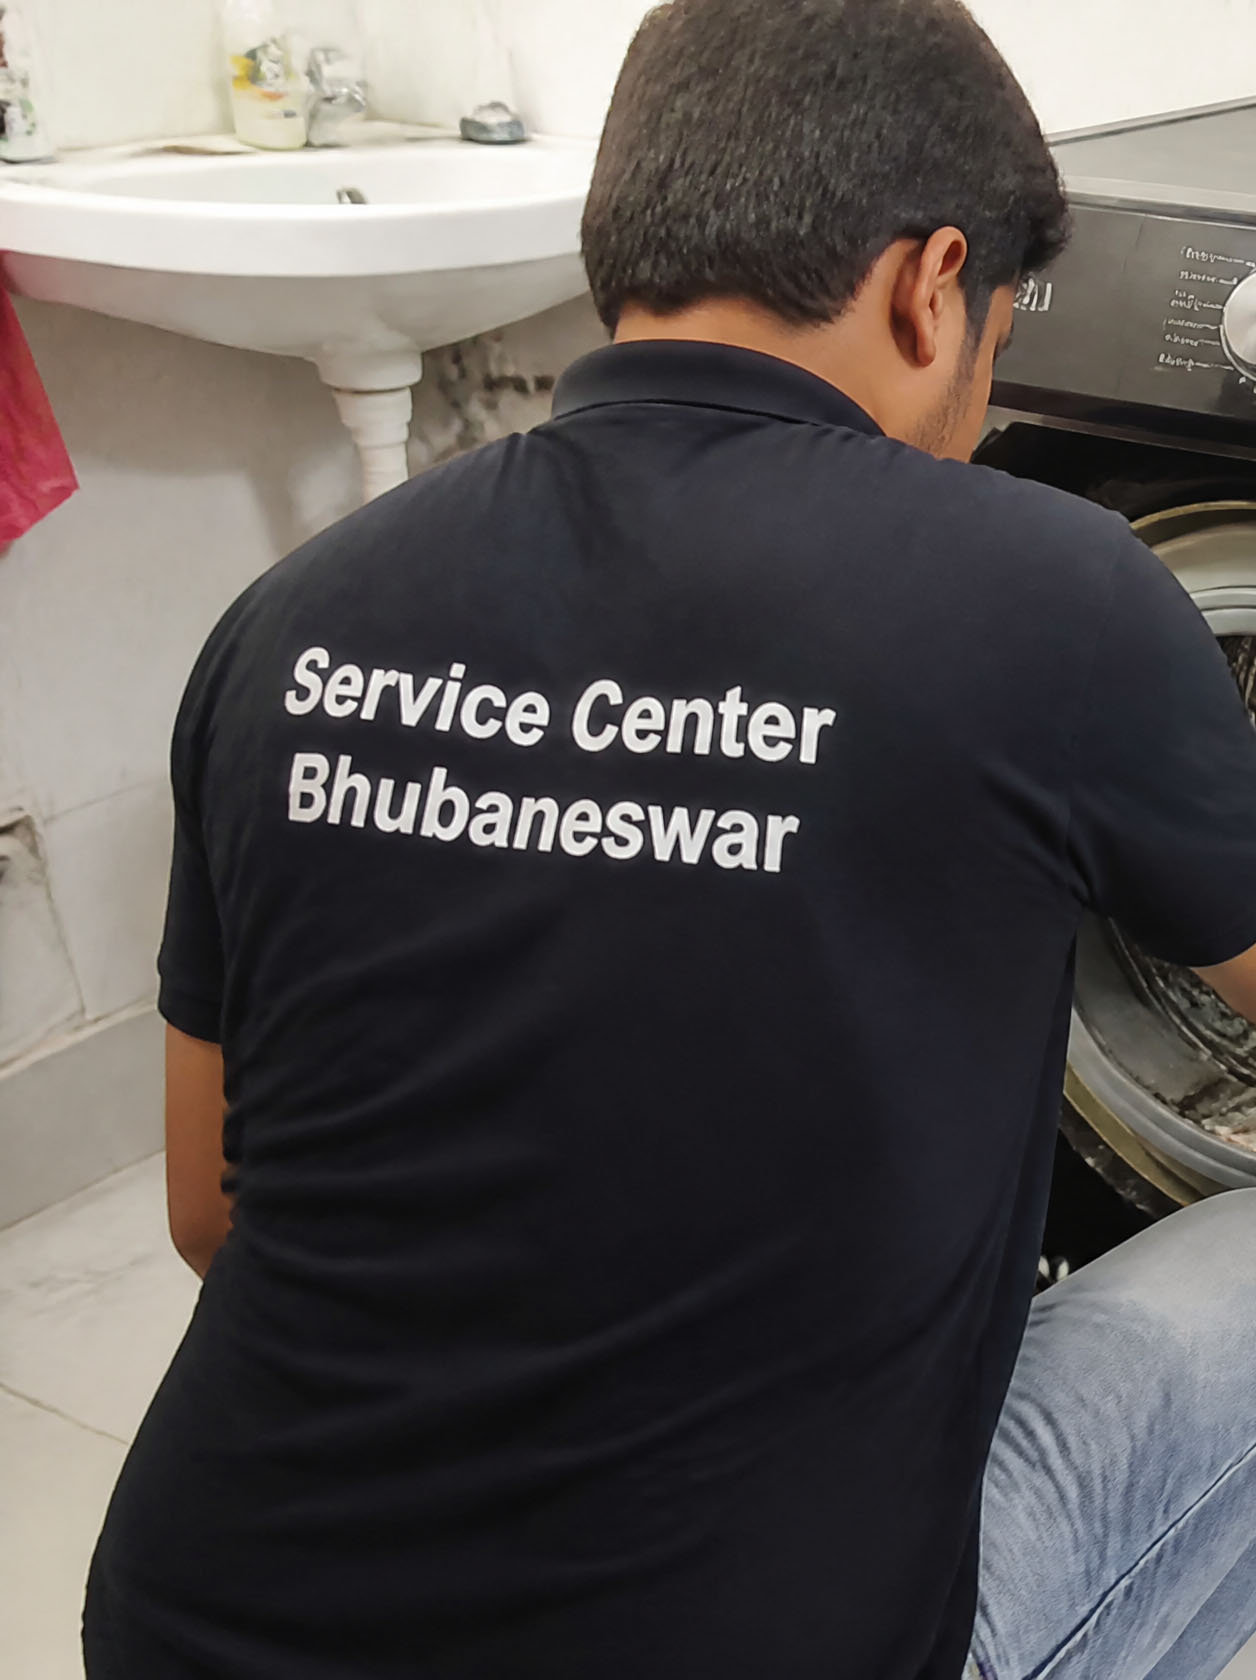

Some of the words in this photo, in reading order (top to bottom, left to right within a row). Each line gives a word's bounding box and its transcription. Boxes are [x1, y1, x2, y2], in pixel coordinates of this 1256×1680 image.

[285, 647, 550, 746] Service
[572, 679, 836, 764] Center
[288, 752, 800, 872] Bhubaneswar
